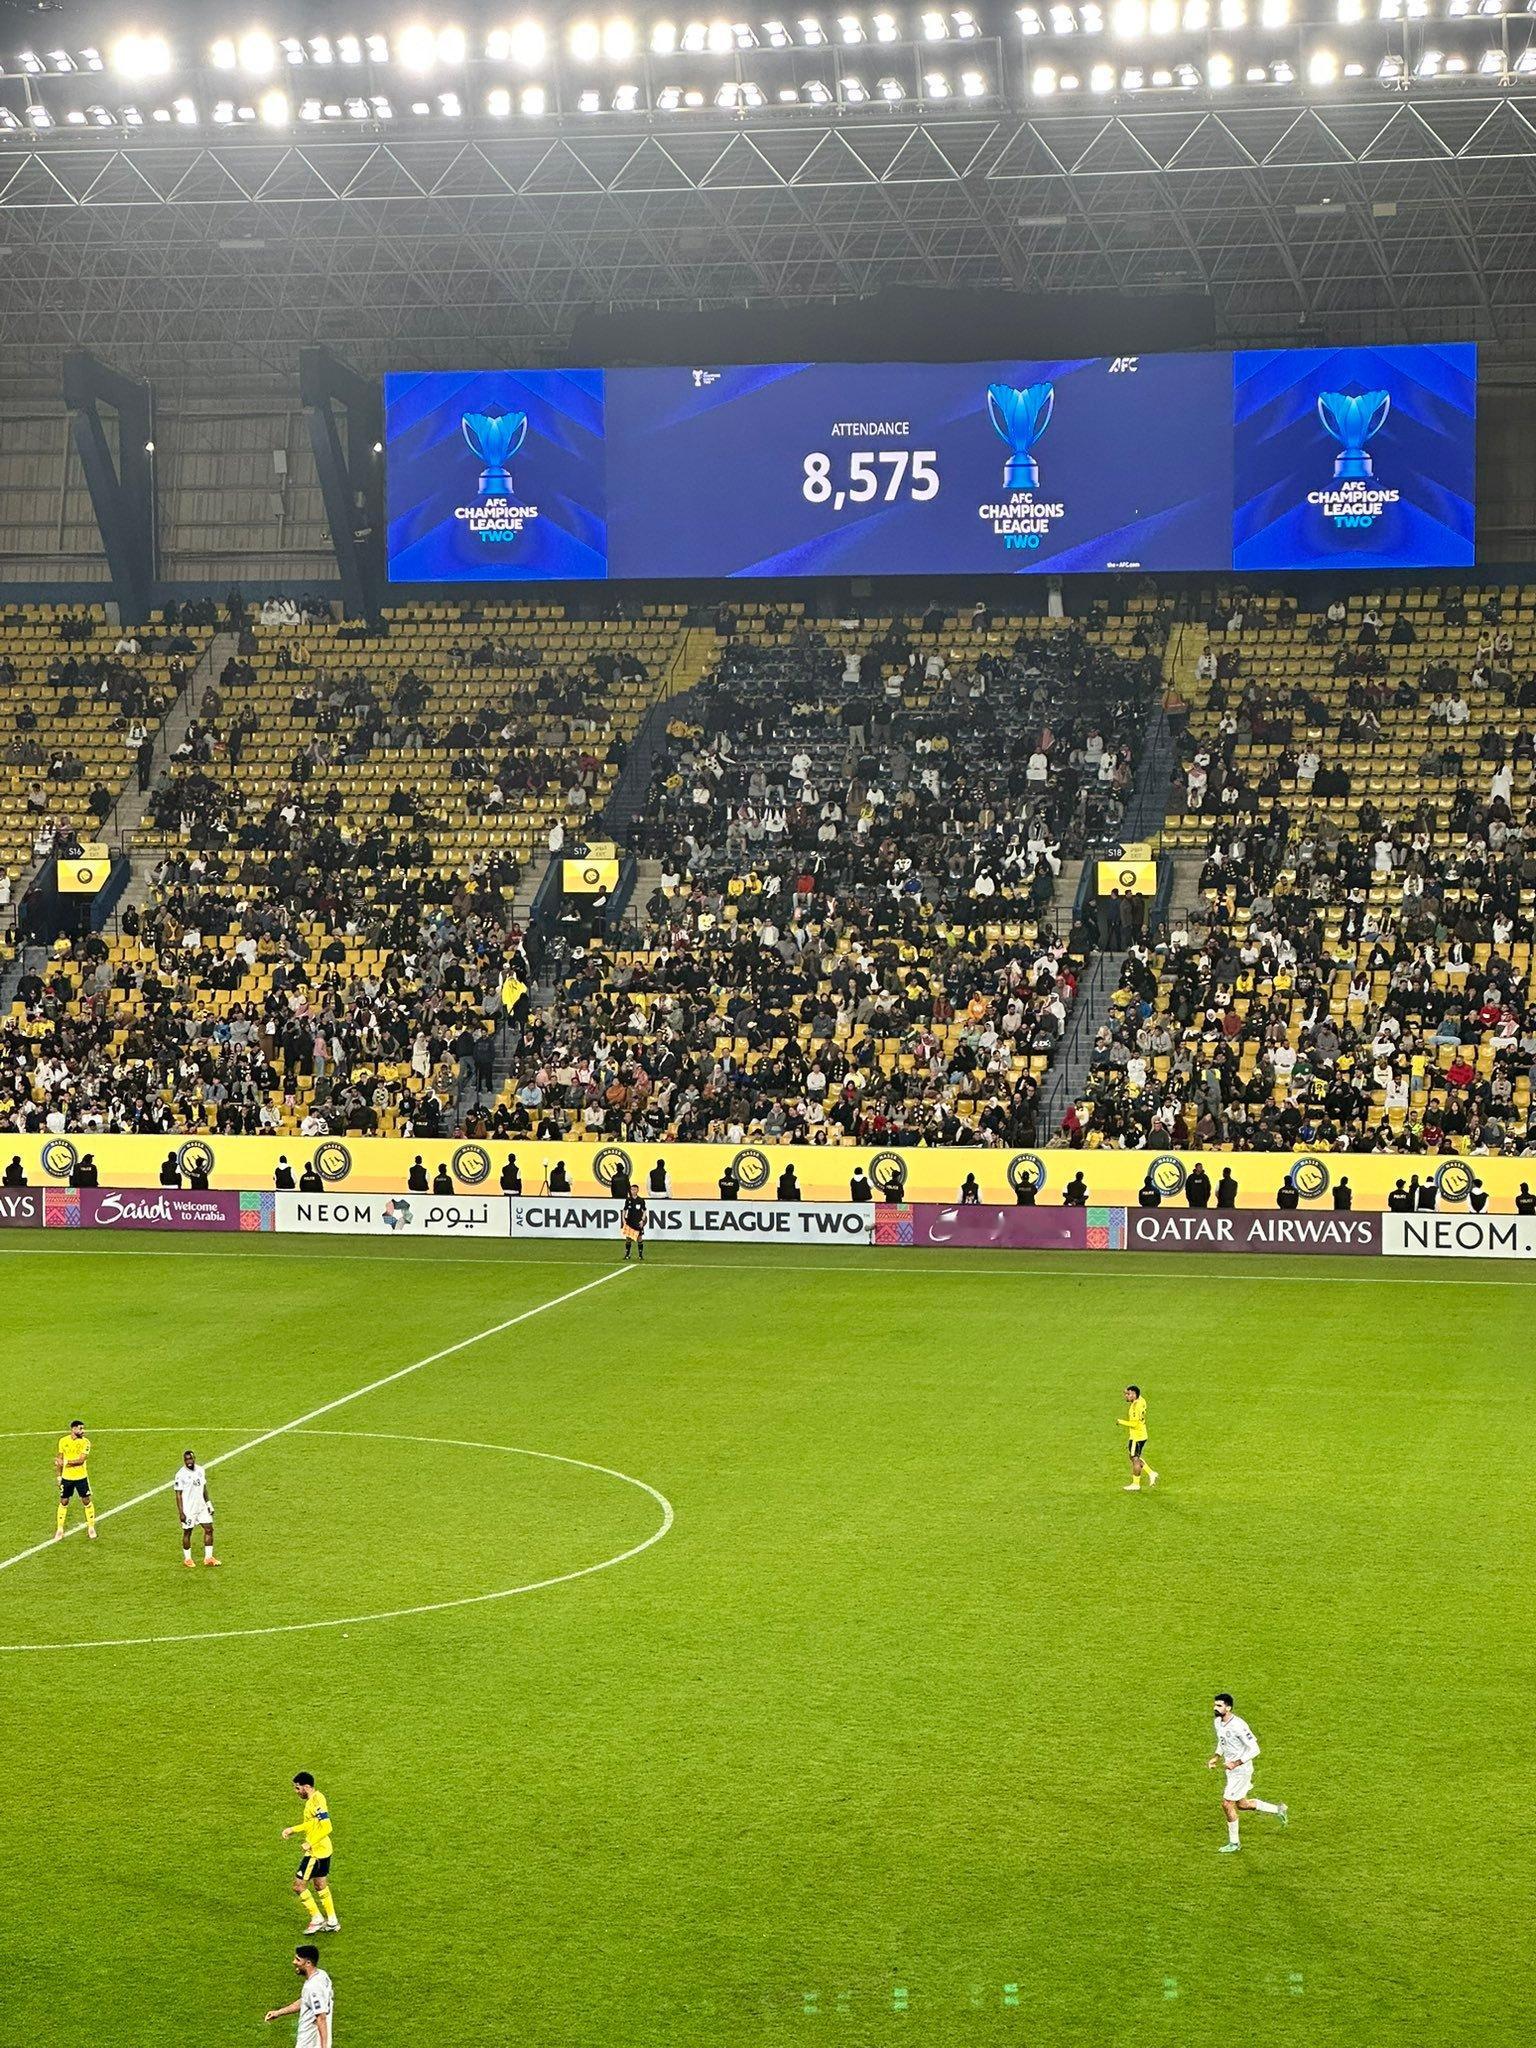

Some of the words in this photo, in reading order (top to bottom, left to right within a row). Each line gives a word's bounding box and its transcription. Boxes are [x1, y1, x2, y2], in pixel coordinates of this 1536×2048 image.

[1108, 357, 1139, 372] AFC
[831, 422, 909, 436] ATTENDANCE
[803, 451, 940, 510] 8,575
[1342, 482, 1366, 490] AFC
[485, 498, 507, 506] AFC
[1010, 493, 1033, 504] AFC
[1307, 490, 1400, 504] CHAMPIONS
[454, 506, 538, 518] CHAMPIONS
[979, 504, 1064, 518] CHAMPIONS
[1324, 503, 1382, 516] LEAGUE
[470, 519, 524, 530] LEAGUE
[994, 519, 1049, 534] LEAGUE
[68, 848, 82, 856] S16
[1108, 848, 1122, 857] S18
[172, 1201, 218, 1212] Welcome
[298, 1204, 371, 1222] NEOM
[181, 1211, 192, 1220] to
[194, 1211, 226, 1221] Arabia
[425, 1204, 488, 1228] نيوم
[690, 1210, 790, 1232] LEAGUE
[1136, 1217, 1234, 1242] QATAR
[1247, 1218, 1373, 1244] AIRWAYS
[1404, 1220, 1532, 1250] NEOM.
